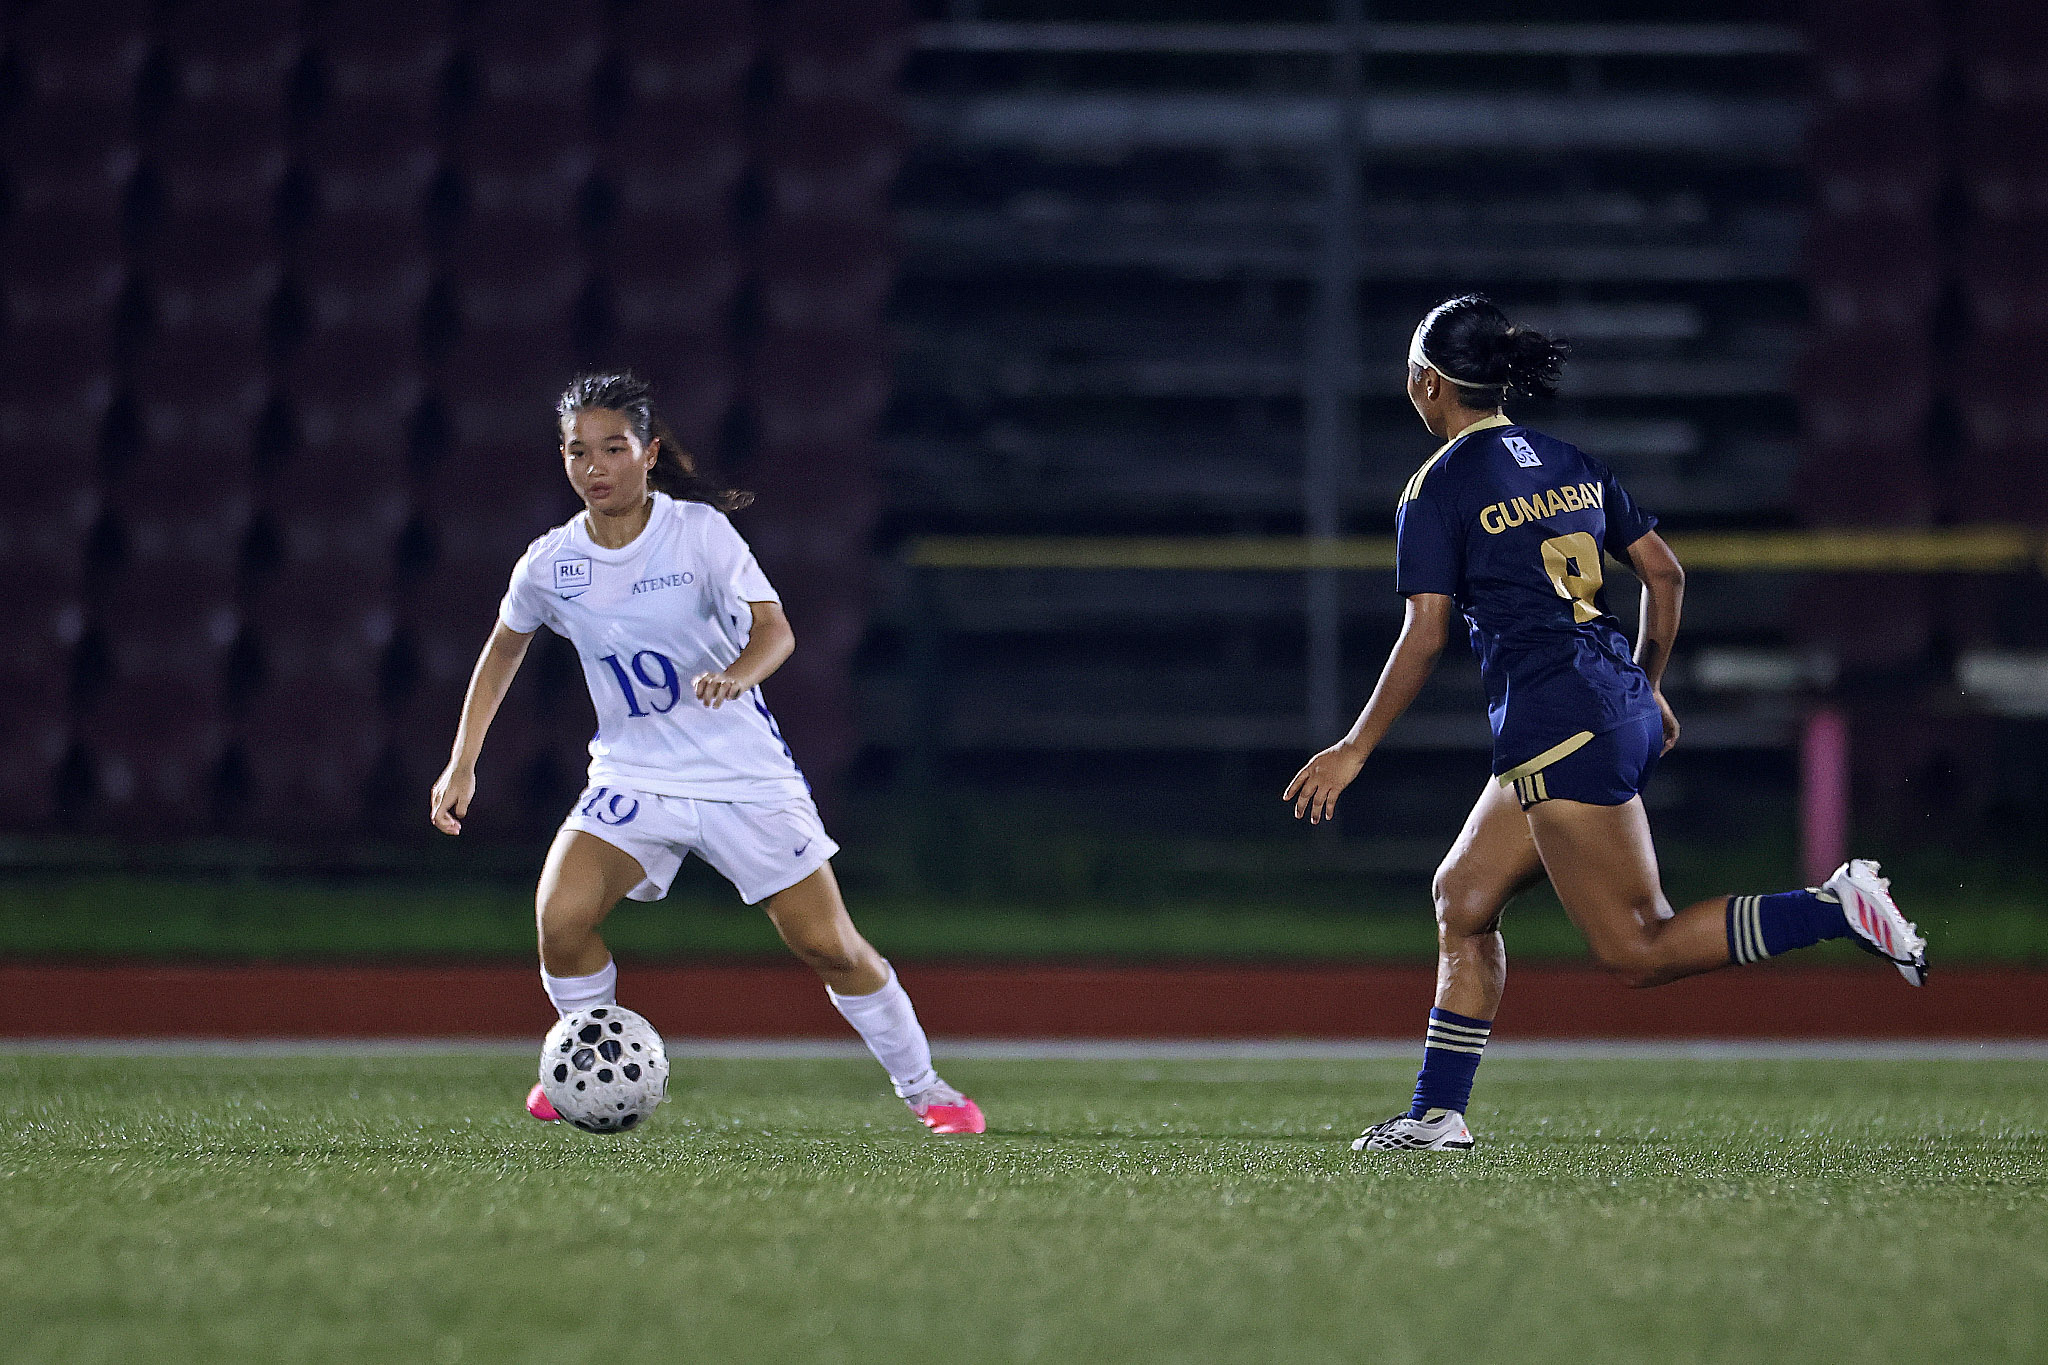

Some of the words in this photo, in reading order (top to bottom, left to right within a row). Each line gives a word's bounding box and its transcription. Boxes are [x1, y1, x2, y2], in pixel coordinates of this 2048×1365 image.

[1480, 482, 1603, 534] GUMABAY
[560, 564, 585, 577] RLC
[632, 572, 695, 595] ATENEO
[1540, 531, 1604, 624] 9
[600, 650, 681, 718] 19
[582, 787, 640, 827] 19
